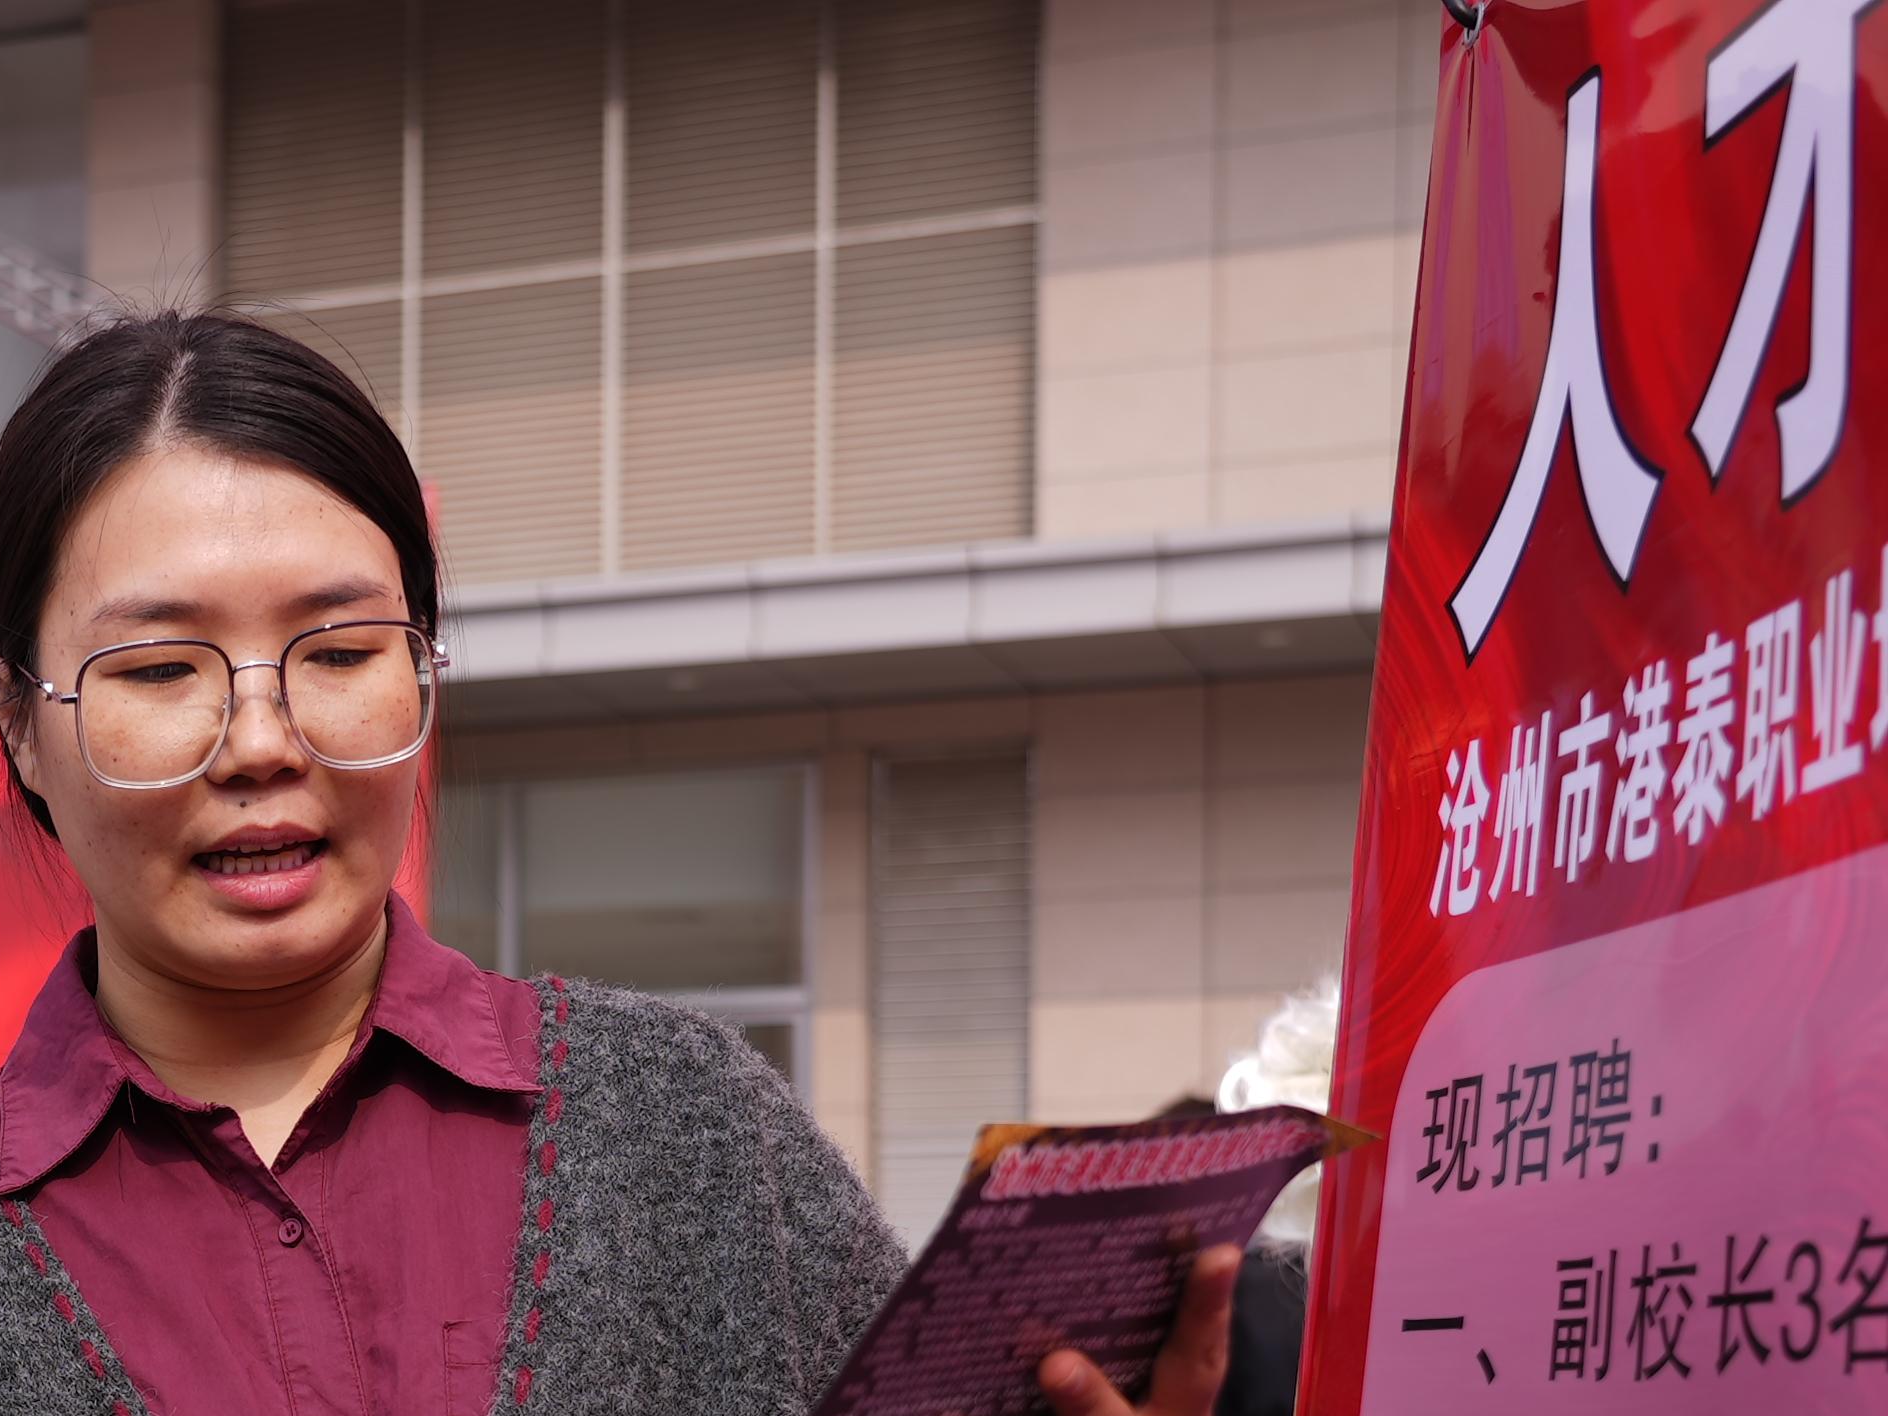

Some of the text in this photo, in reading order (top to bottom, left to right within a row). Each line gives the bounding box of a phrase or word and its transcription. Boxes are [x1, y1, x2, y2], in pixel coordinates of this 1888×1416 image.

[1446, 0, 1888, 666] 人才
[1429, 543, 1888, 920] 沧州市港泰职业
[1417, 1037, 1665, 1194] 现招聘：
